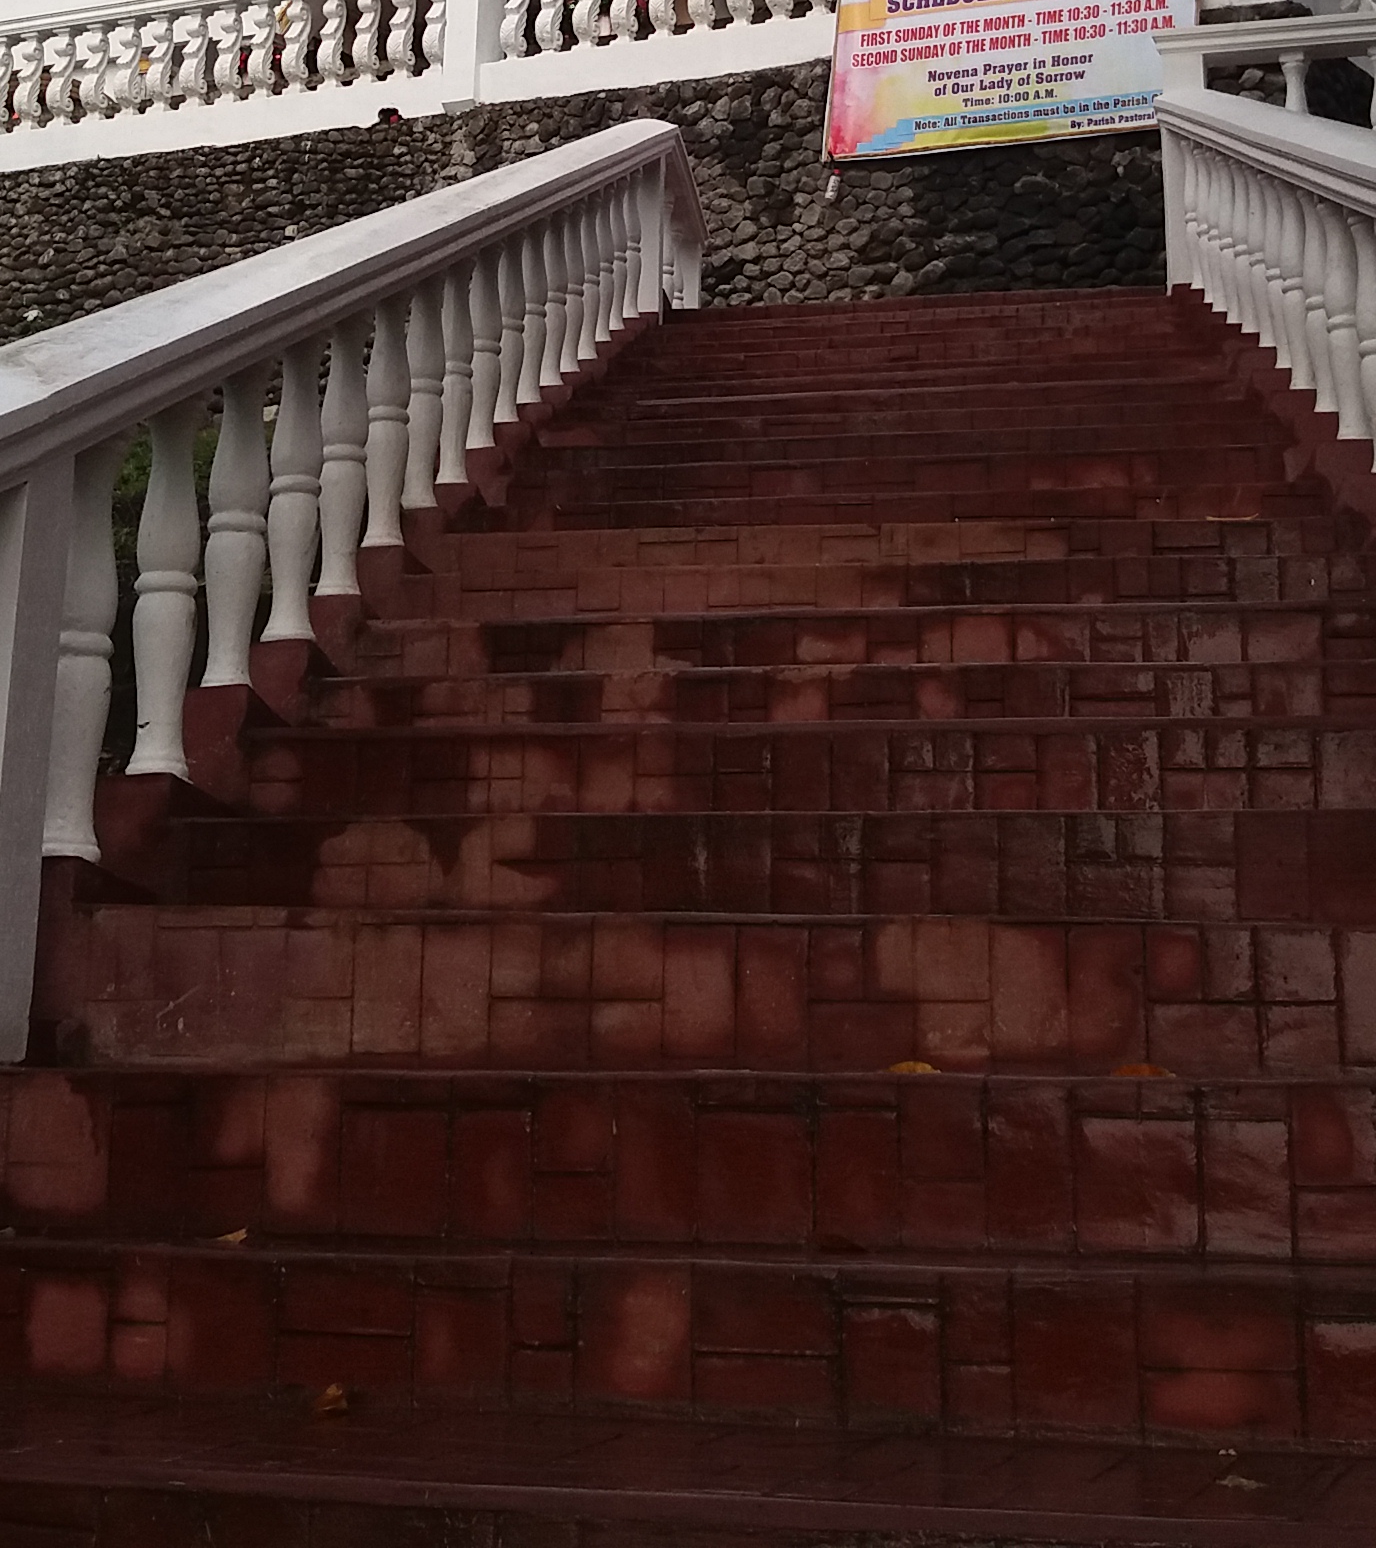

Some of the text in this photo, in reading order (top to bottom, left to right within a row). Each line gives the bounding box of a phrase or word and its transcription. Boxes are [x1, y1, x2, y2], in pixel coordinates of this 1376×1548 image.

[861, 31, 893, 47] FIRST
[894, 25, 941, 43] SUNDAY
[943, 23, 958, 37] OF
[960, 20, 980, 34] THE
[983, 14, 1025, 28] MONTH
[1036, 9, 1064, 25] TIME
[1067, 5, 1100, 21] 10:30
[1110, 0, 1141, 16] 11:30
[852, 15, 1175, 67] SECOND SUNDAY OF THE MONTH TIME 10:30 11:30 A.M.
[927, 54, 1093, 82] Novena Prayer in Honor
[934, 70, 1085, 96] of Our Lady of Sorrow
[962, 89, 1058, 107] Time: 10:00 A.M.
[914, 120, 940, 131] Note:
[943, 118, 957, 127] All
[961, 109, 1030, 125] Transactions
[1033, 106, 1059, 117] must
[1063, 104, 1076, 114] be
[1079, 102, 1090, 112] in
[1093, 100, 1110, 110] the
[1113, 95, 1148, 108] Parish
[1070, 111, 1155, 129] By: Parish Pastoral
